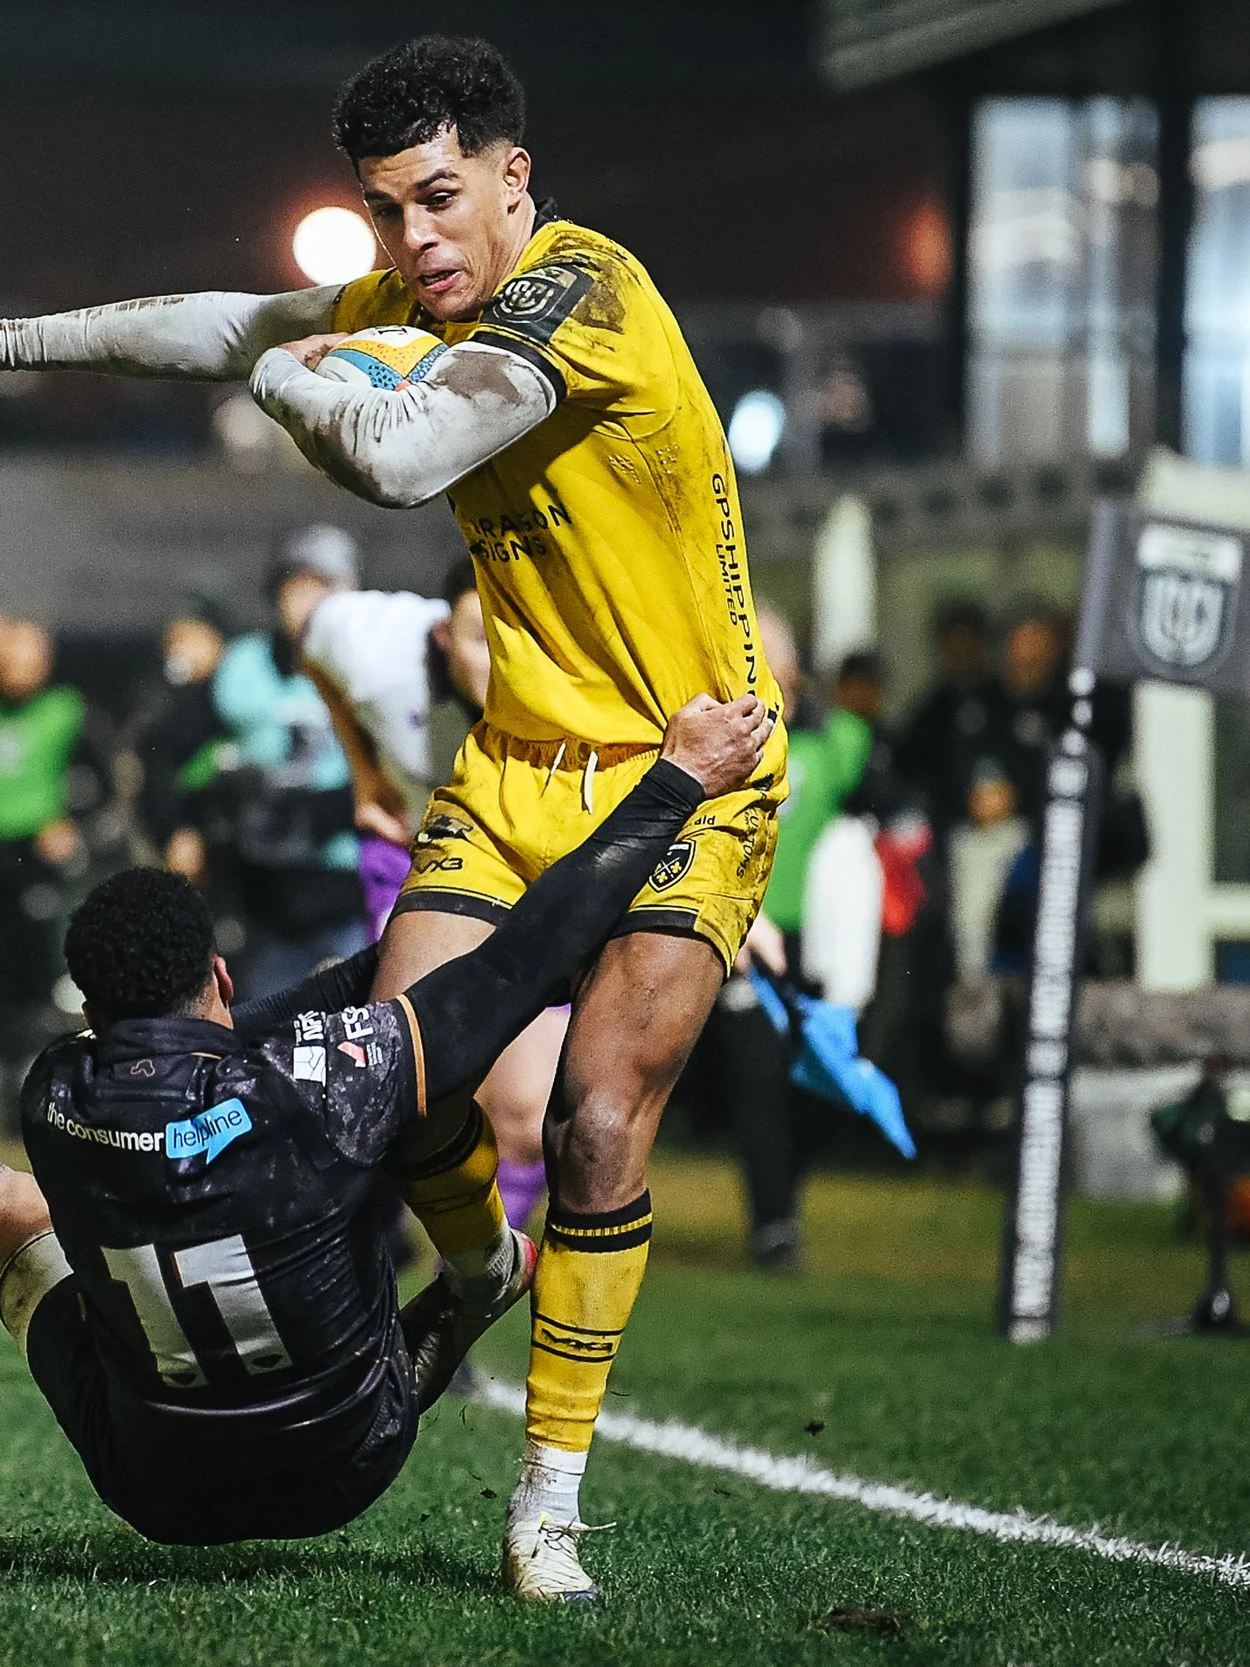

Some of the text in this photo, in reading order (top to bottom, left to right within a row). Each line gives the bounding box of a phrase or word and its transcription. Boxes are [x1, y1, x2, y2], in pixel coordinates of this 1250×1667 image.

[716, 544, 738, 626] LIMITED
[47, 1101, 243, 1152] the consumer helpline
[99, 1233, 295, 1390] 11
